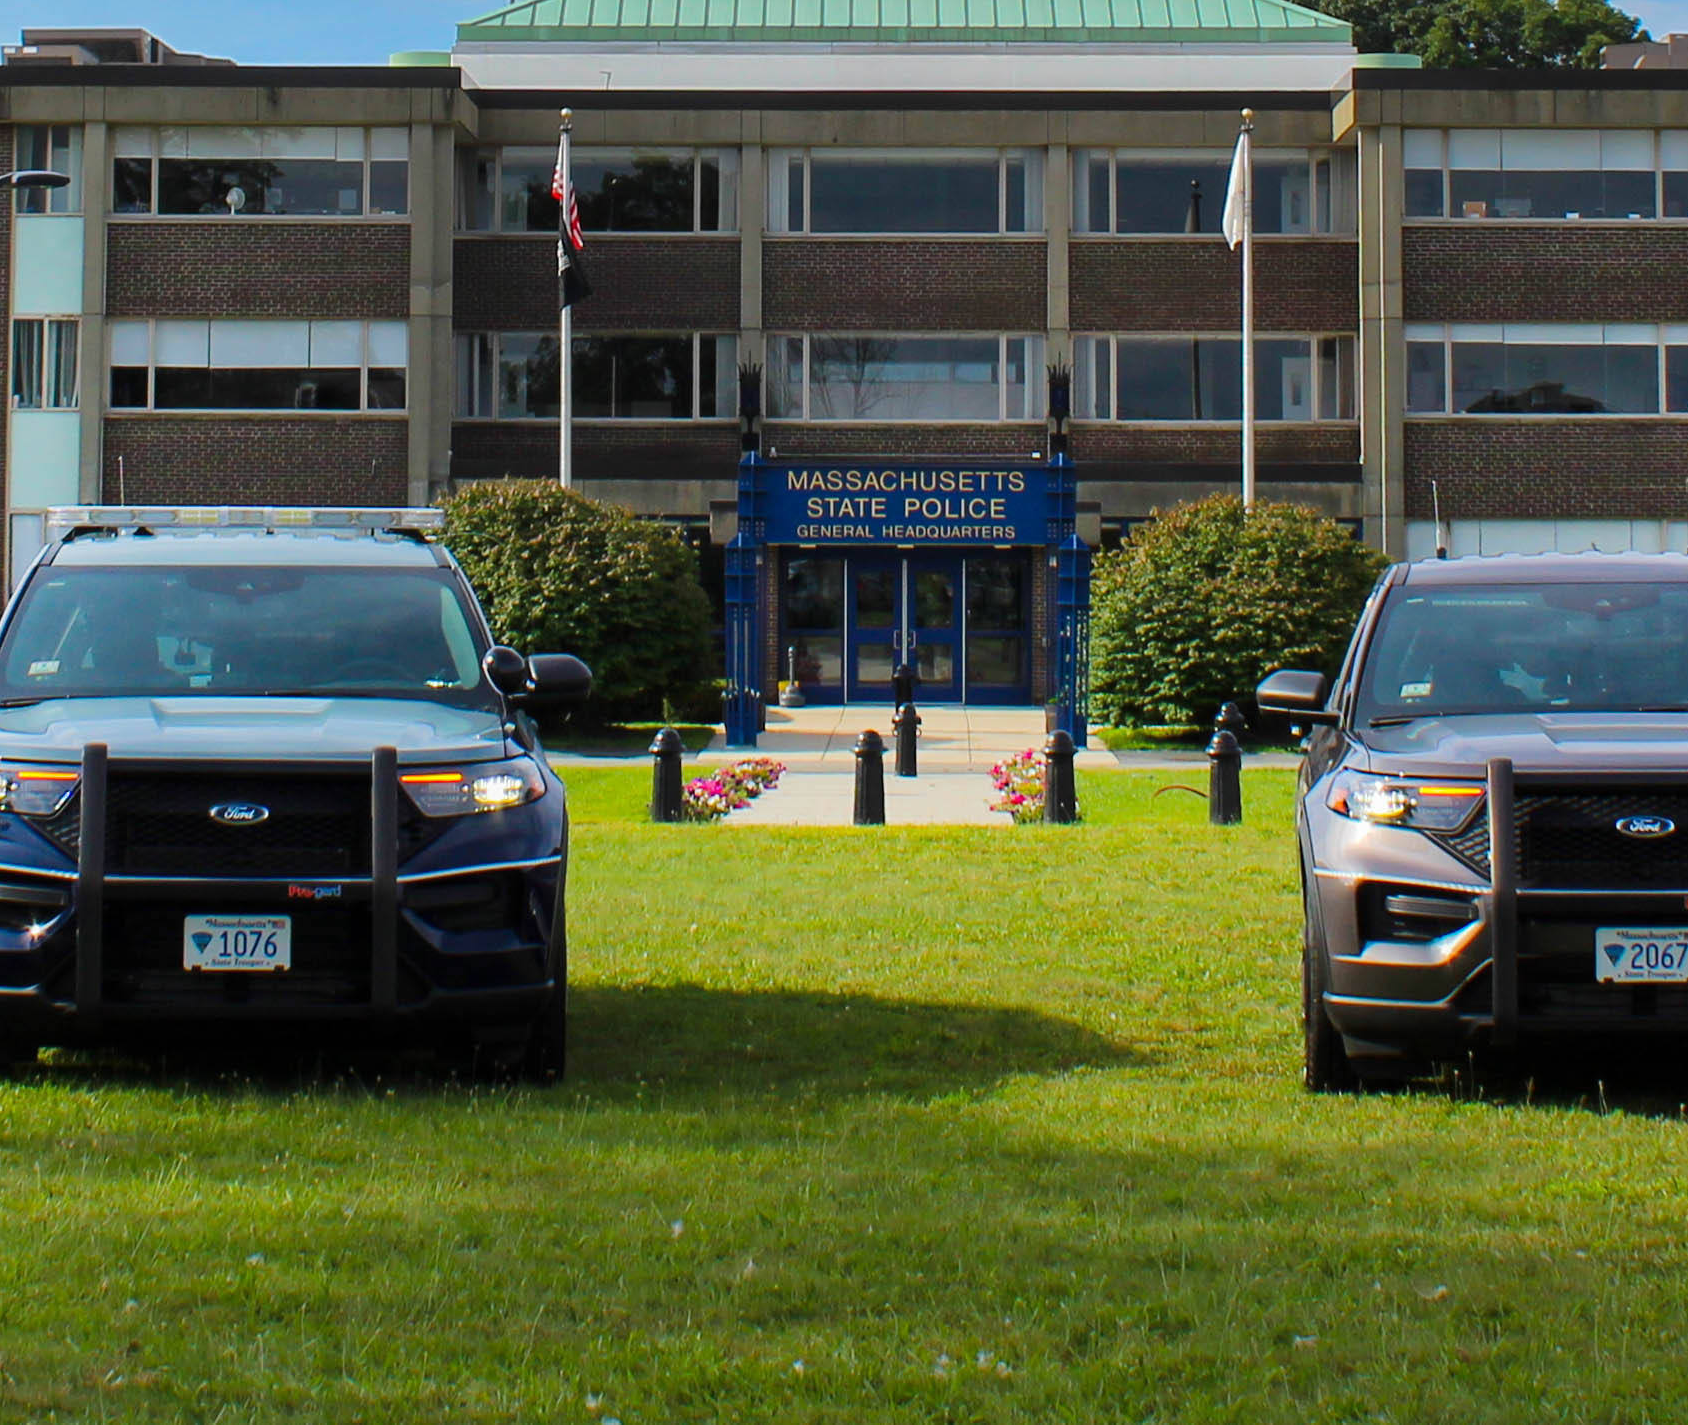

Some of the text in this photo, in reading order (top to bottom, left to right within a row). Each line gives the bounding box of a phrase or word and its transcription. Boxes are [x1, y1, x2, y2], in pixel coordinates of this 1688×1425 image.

[787, 470, 1025, 492] MASSACHUSETTS
[807, 497, 1007, 519] STATE POLICE
[796, 524, 1016, 539] GENERAL HEADQUARTERS
[223, 806, 255, 820] Ford
[1629, 818, 1661, 832] Ford
[219, 930, 278, 958] 1076
[1631, 942, 1688, 970] 2067
